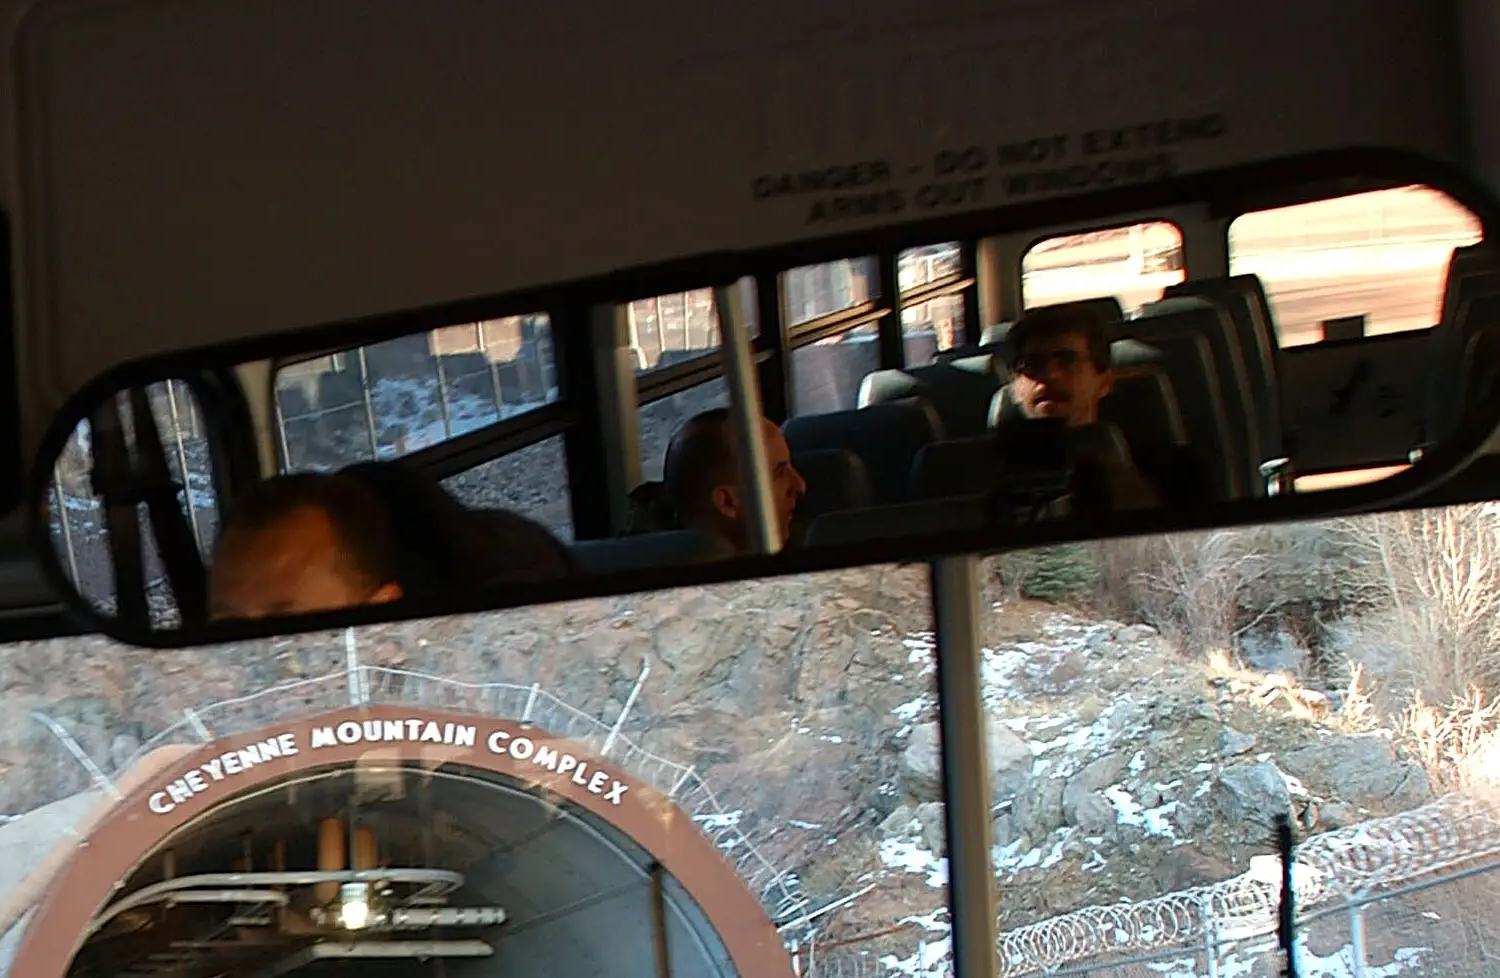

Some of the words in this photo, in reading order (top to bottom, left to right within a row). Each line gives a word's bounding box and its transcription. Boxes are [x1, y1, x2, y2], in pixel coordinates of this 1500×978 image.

[750, 160, 892, 200] DANGER
[933, 146, 988, 176] DO
[997, 131, 1068, 163] NOT
[1083, 112, 1226, 156] EXTEND
[805, 187, 907, 225] ARMS
[918, 176, 986, 209] OUT
[1003, 153, 1180, 196] WINDOWS
[148, 733, 298, 815] CHEYENNE
[310, 719, 476, 749] MOUNTAIN
[487, 731, 629, 805] COMPLEX
